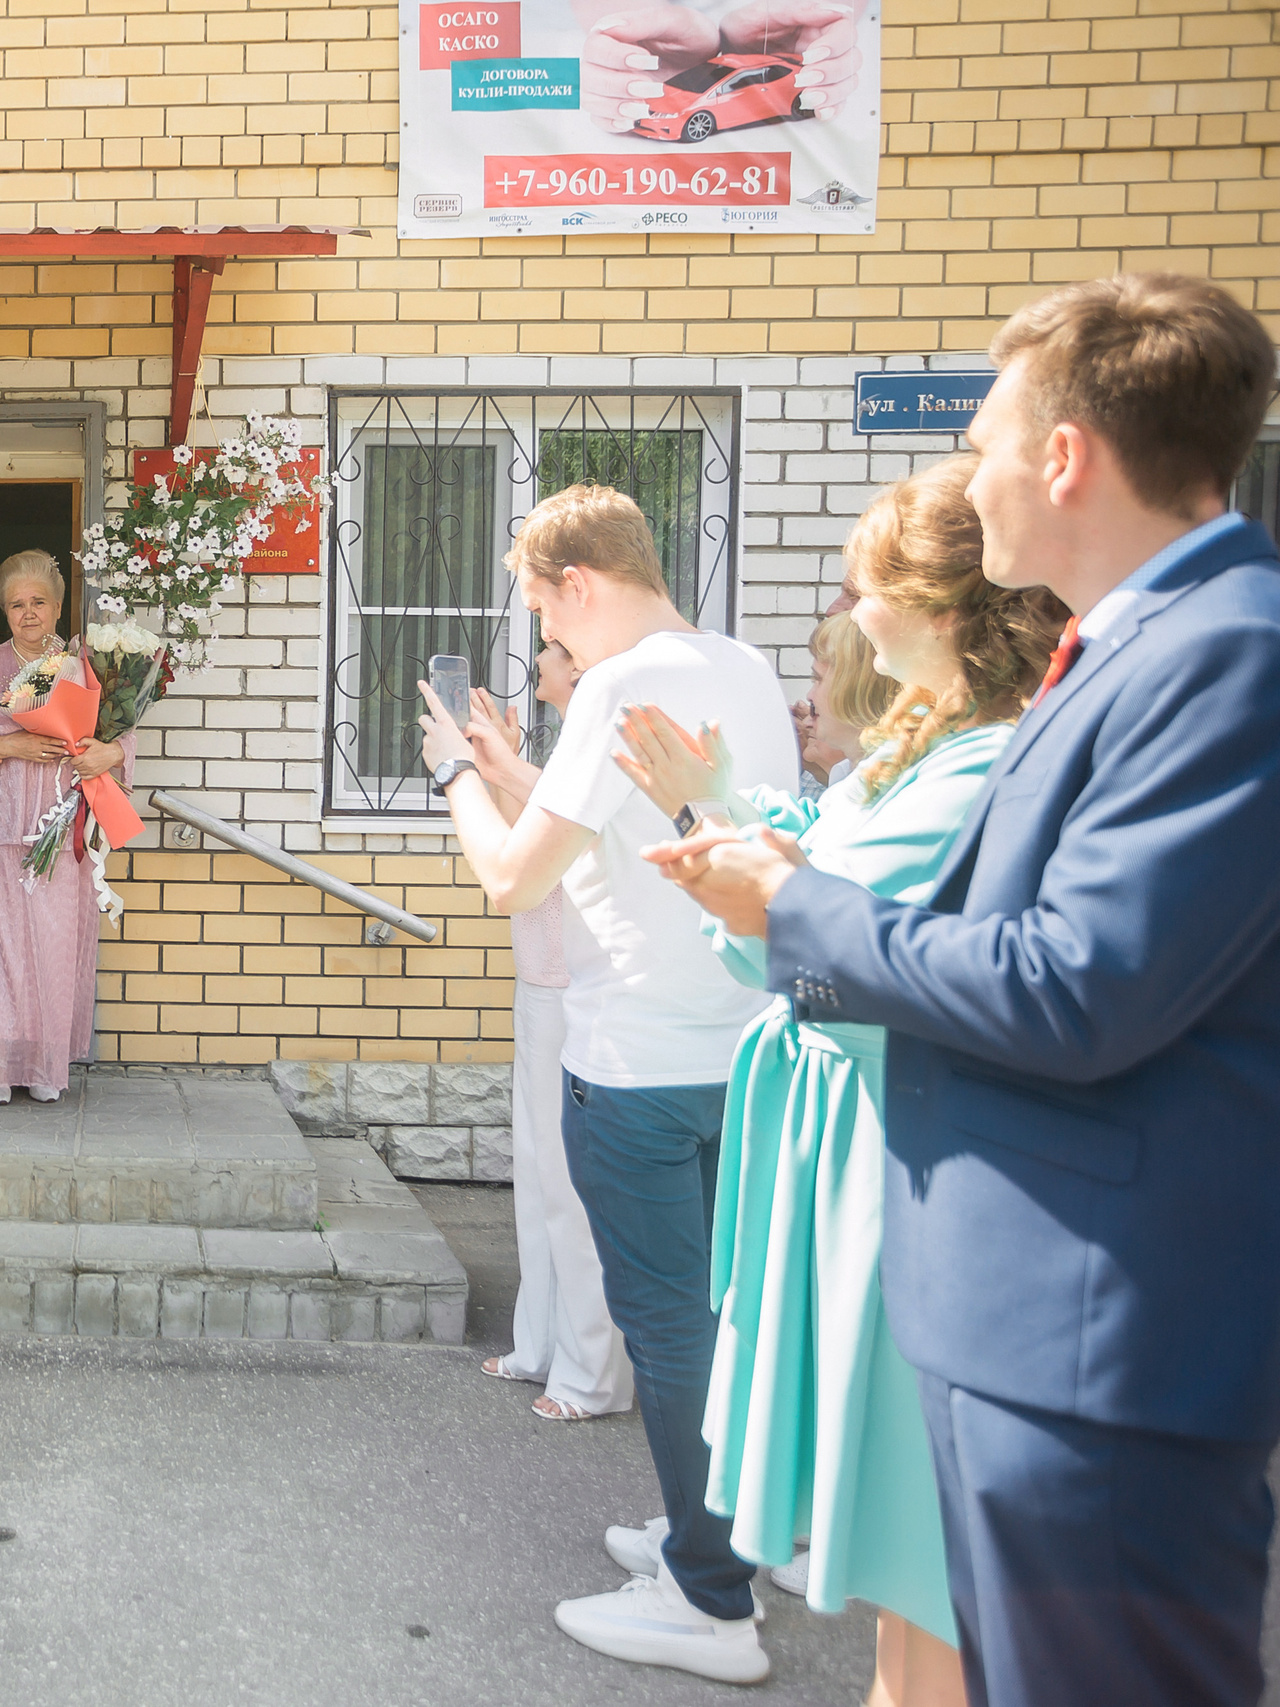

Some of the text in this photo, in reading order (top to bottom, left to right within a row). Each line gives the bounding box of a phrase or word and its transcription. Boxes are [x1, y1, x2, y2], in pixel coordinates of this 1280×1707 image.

[438, 11, 499, 28] ОСАГО
[438, 35, 499, 52] КАСКО
[480, 69, 549, 83] ДОГОВОРА
[458, 85, 572, 99] КУПЛИ-ПРОДАЖИ
[495, 166, 778, 197] +7-960-190-62-81
[488, 214, 528, 223] ИНГОССТРАХ
[561, 217, 584, 226] ВСК
[656, 212, 688, 223] РЕСО
[731, 211, 778, 221] ЮГОРИЯ
